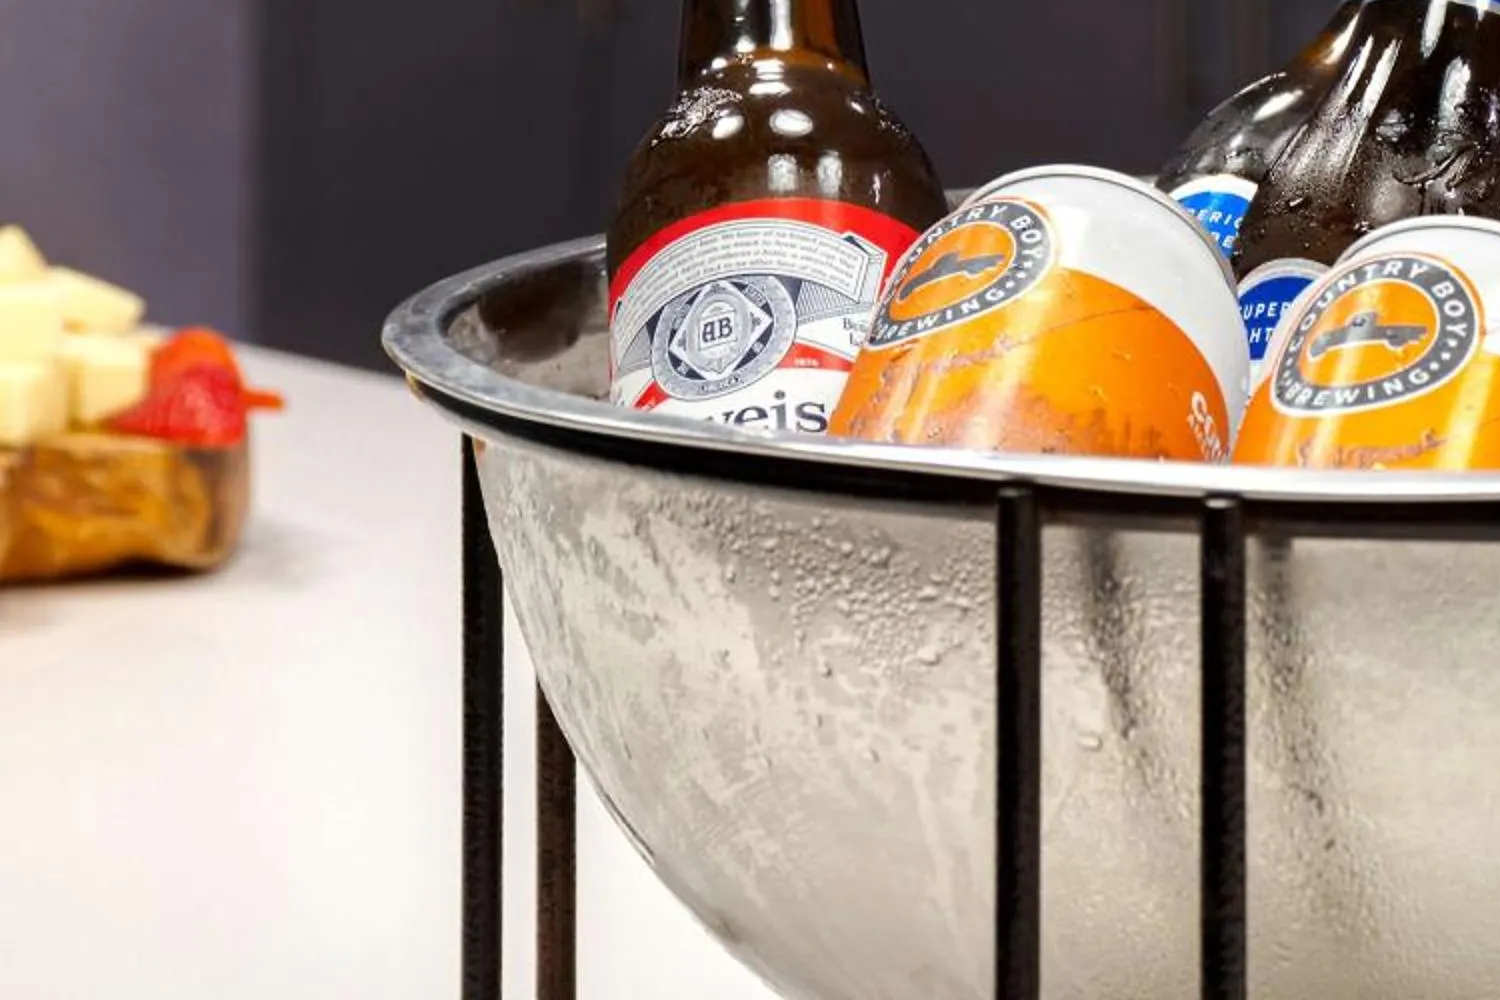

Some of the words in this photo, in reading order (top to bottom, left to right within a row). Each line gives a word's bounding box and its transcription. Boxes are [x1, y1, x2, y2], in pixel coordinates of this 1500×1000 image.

[1010, 214, 1043, 259] BOY
[1288, 260, 1429, 352] COUNTRY
[1431, 280, 1468, 338] BOY
[1284, 369, 1431, 406] BREWING
